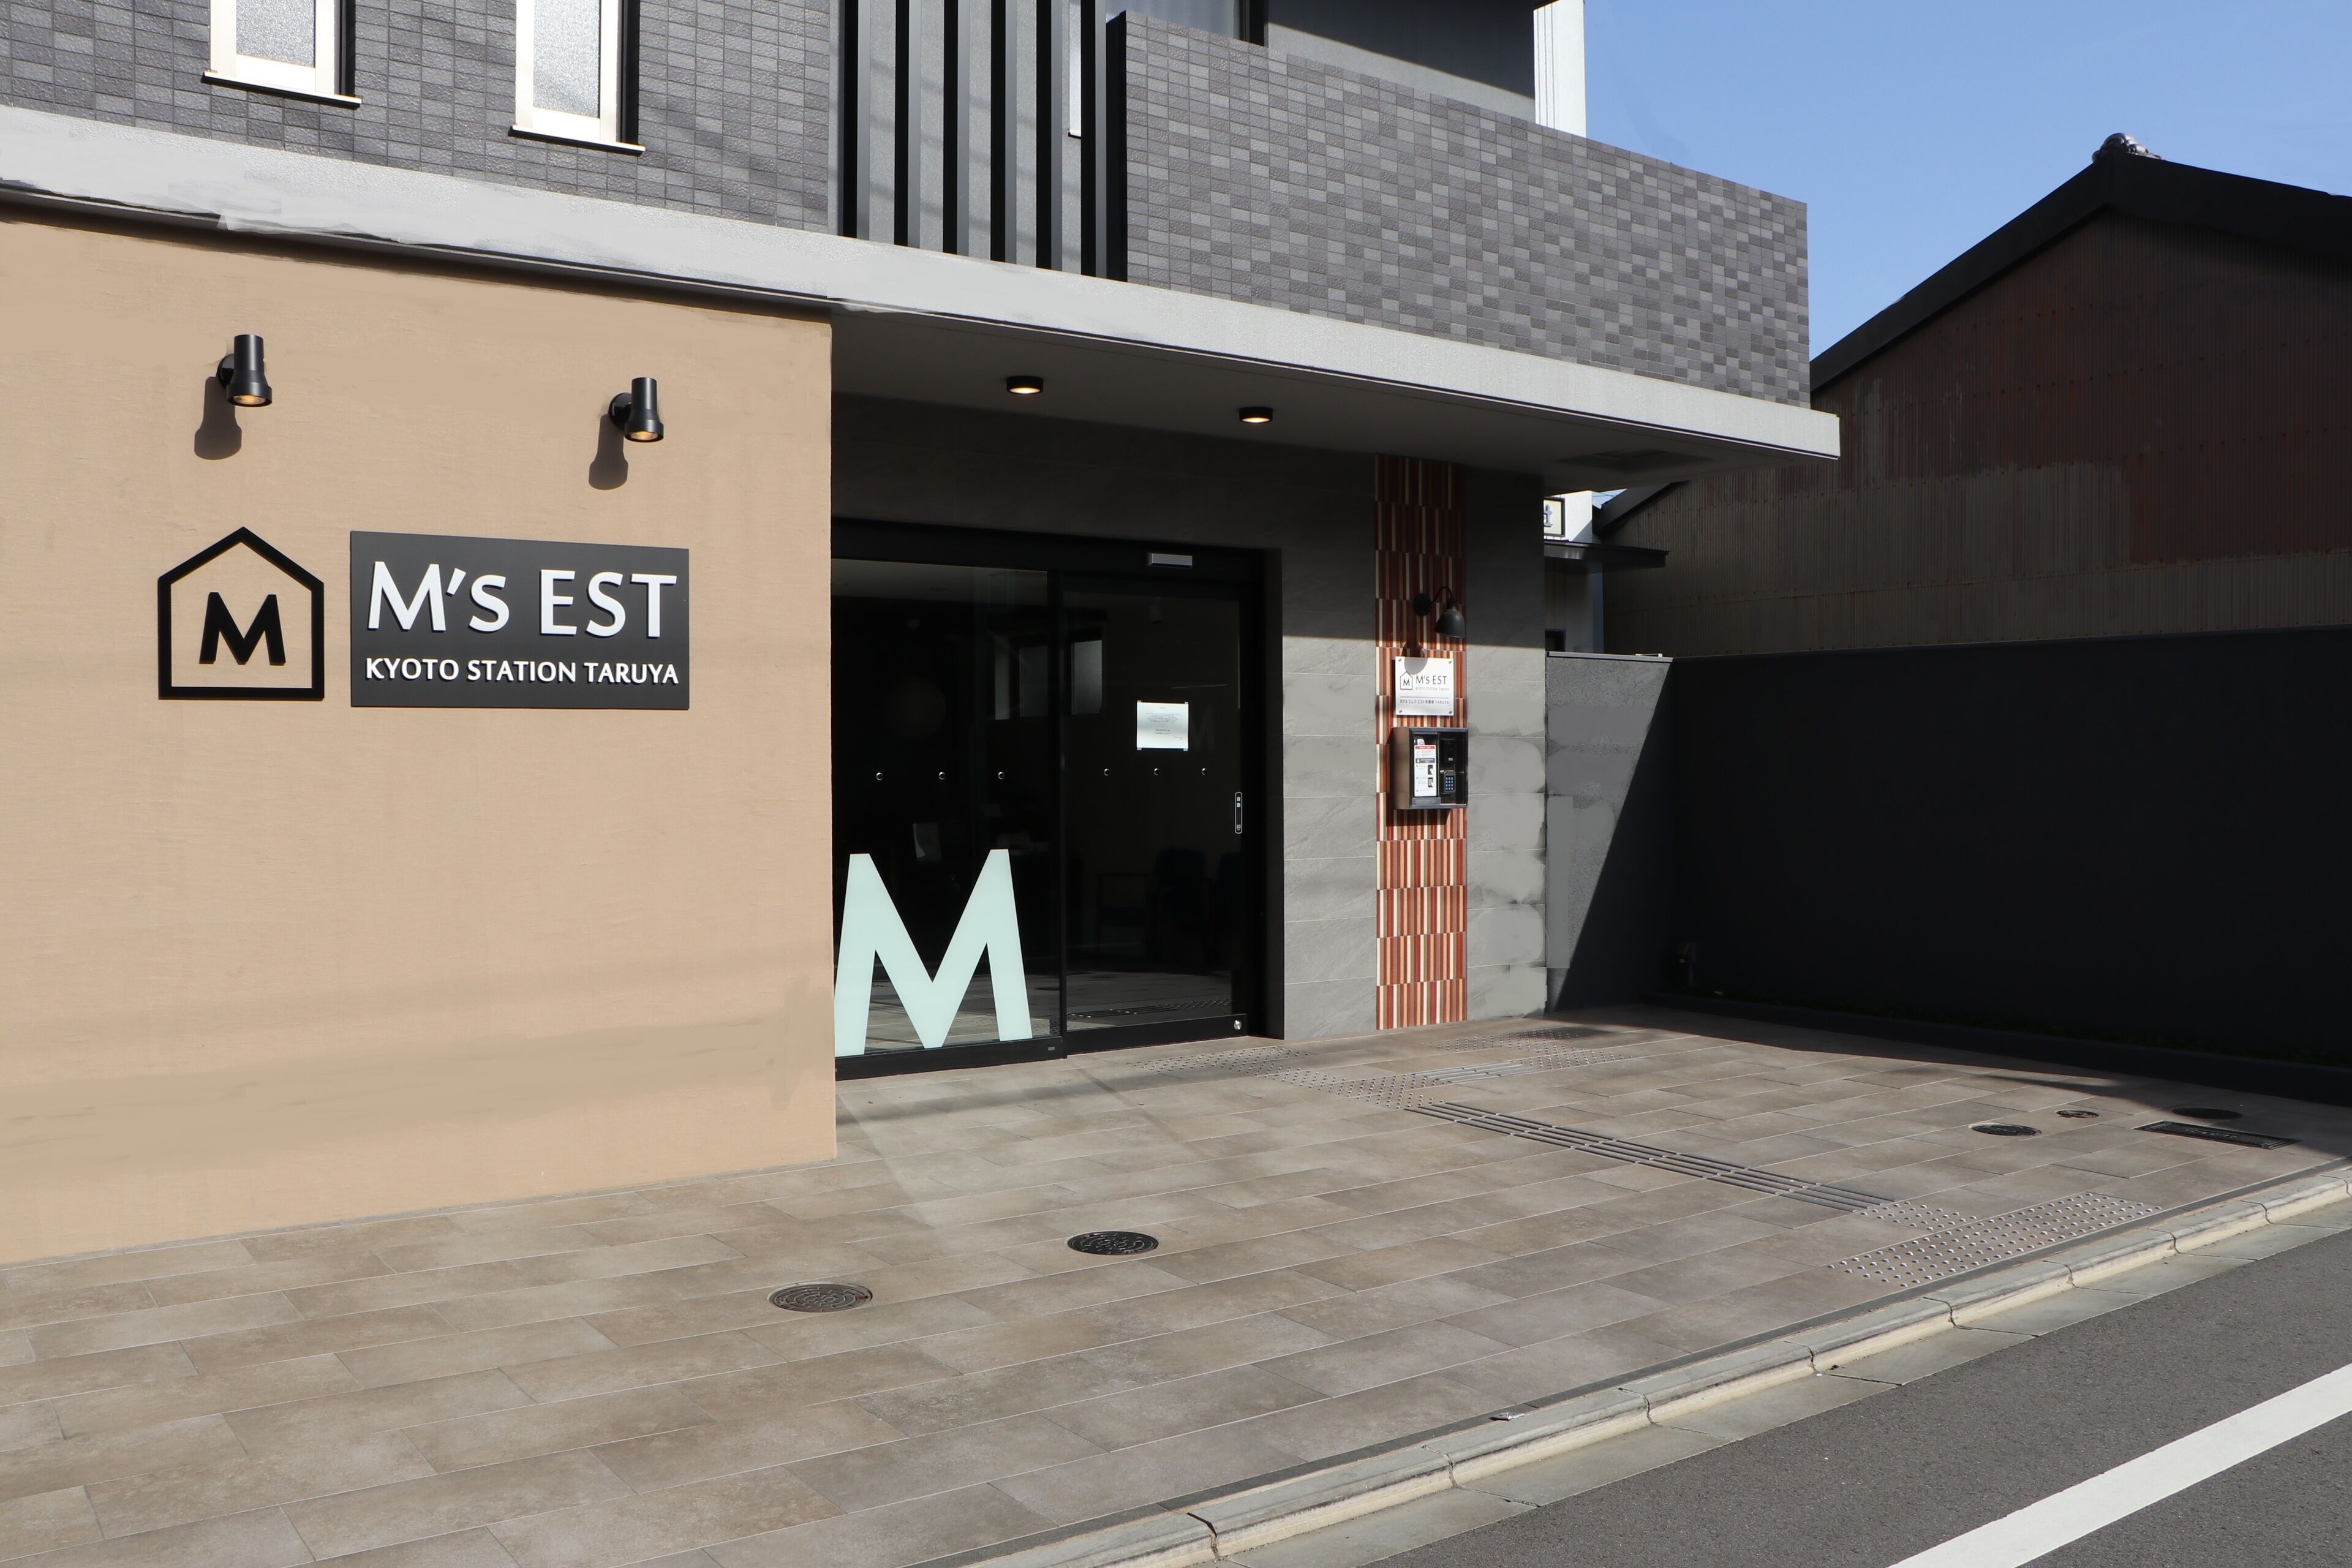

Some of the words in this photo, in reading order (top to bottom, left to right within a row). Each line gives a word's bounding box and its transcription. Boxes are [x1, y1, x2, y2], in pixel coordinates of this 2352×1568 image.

[198, 592, 286, 666] M
[368, 560, 510, 632] M's
[540, 569, 677, 638] EST
[366, 657, 459, 680] KYOTO
[467, 660, 576, 682] STATION
[584, 662, 679, 684] TARUYA
[1415, 675, 1430, 684] M's
[1433, 676, 1447, 685] EST
[834, 848, 1033, 1057] M
